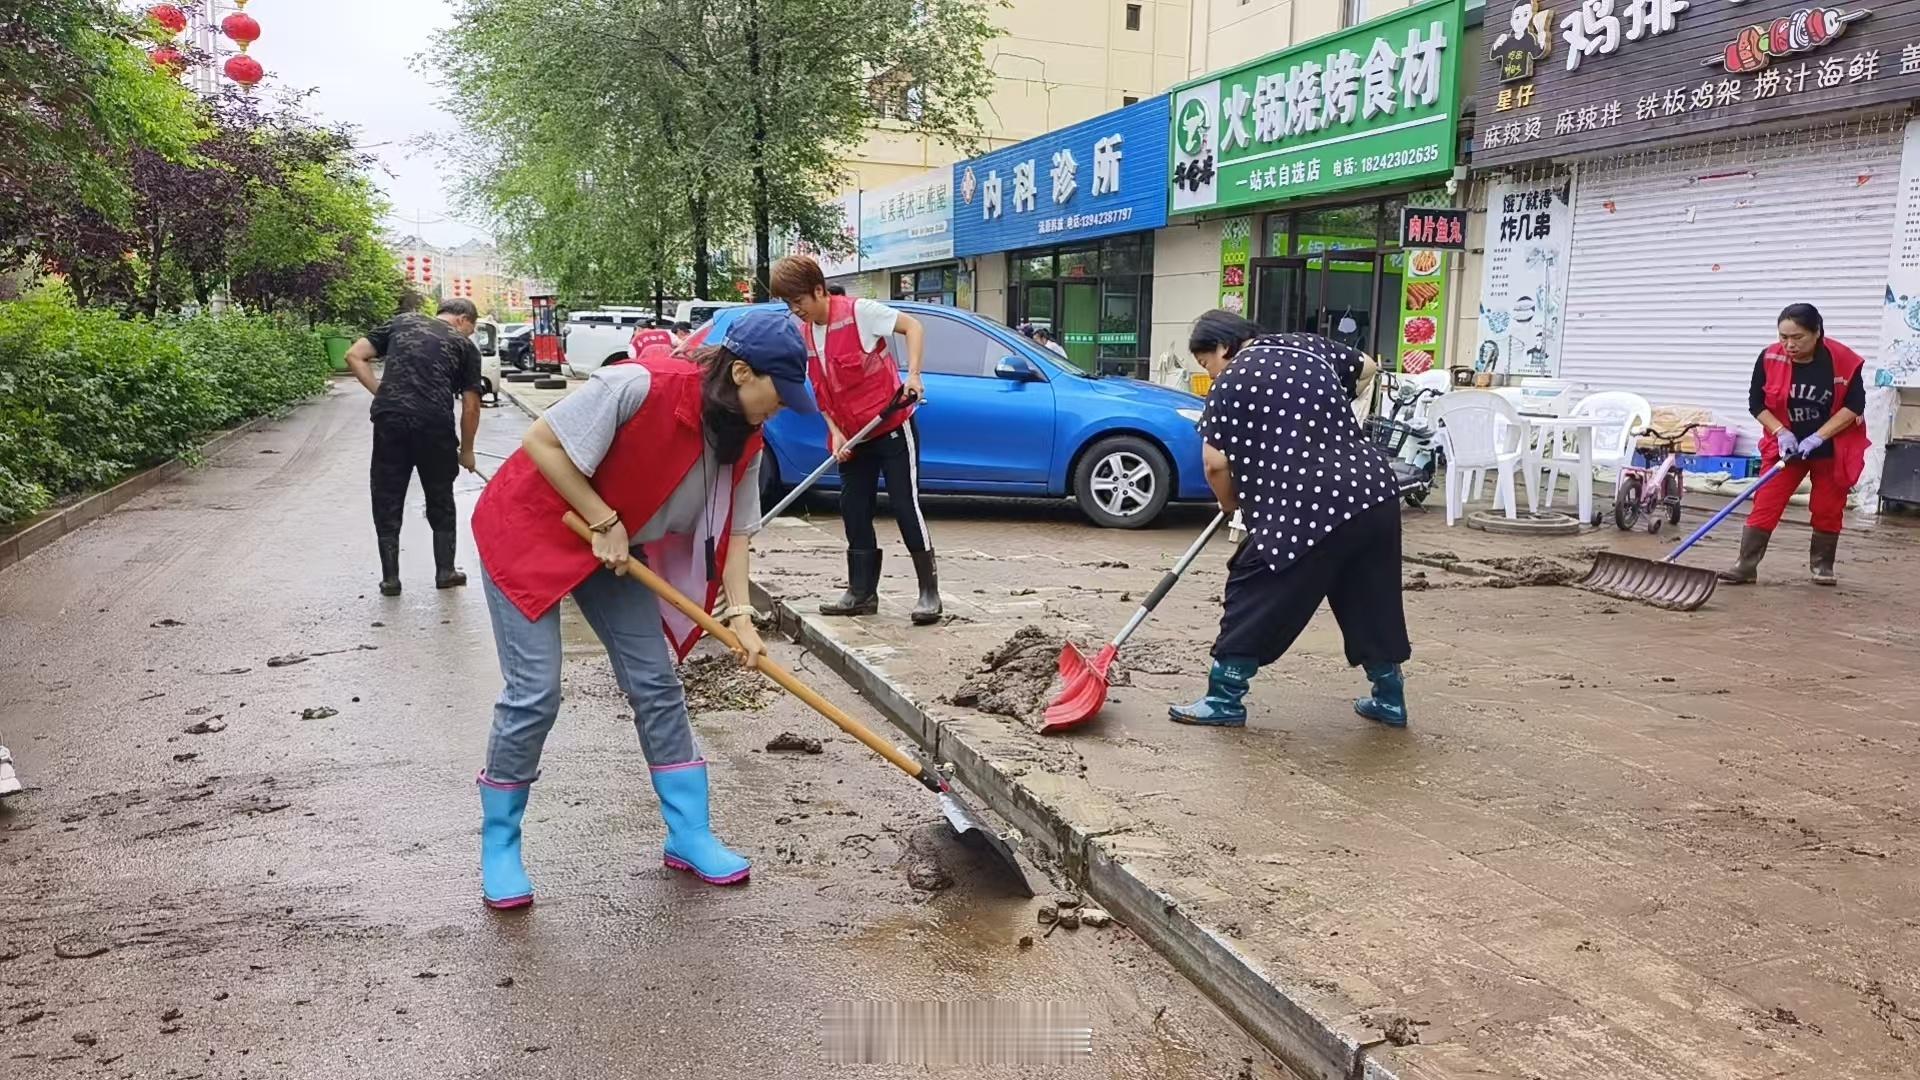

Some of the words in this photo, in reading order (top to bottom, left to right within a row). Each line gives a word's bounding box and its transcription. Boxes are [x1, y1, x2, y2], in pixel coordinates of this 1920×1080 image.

[1560, 0, 1690, 71] 鸡排
[1220, 21, 1448, 152] 火锅烧烤食材
[1496, 84, 1535, 111] 星仔
[1484, 117, 1542, 148] 麻辣烫
[1555, 100, 1623, 135] 麻辣拌
[1636, 79, 1741, 119] 铁板鸡架
[983, 133, 1124, 220] 内科诊所
[1235, 157, 1321, 192] 一站式自选店
[1408, 214, 1463, 244] 肉片鱼丸
[1500, 211, 1551, 242] 炸几串
